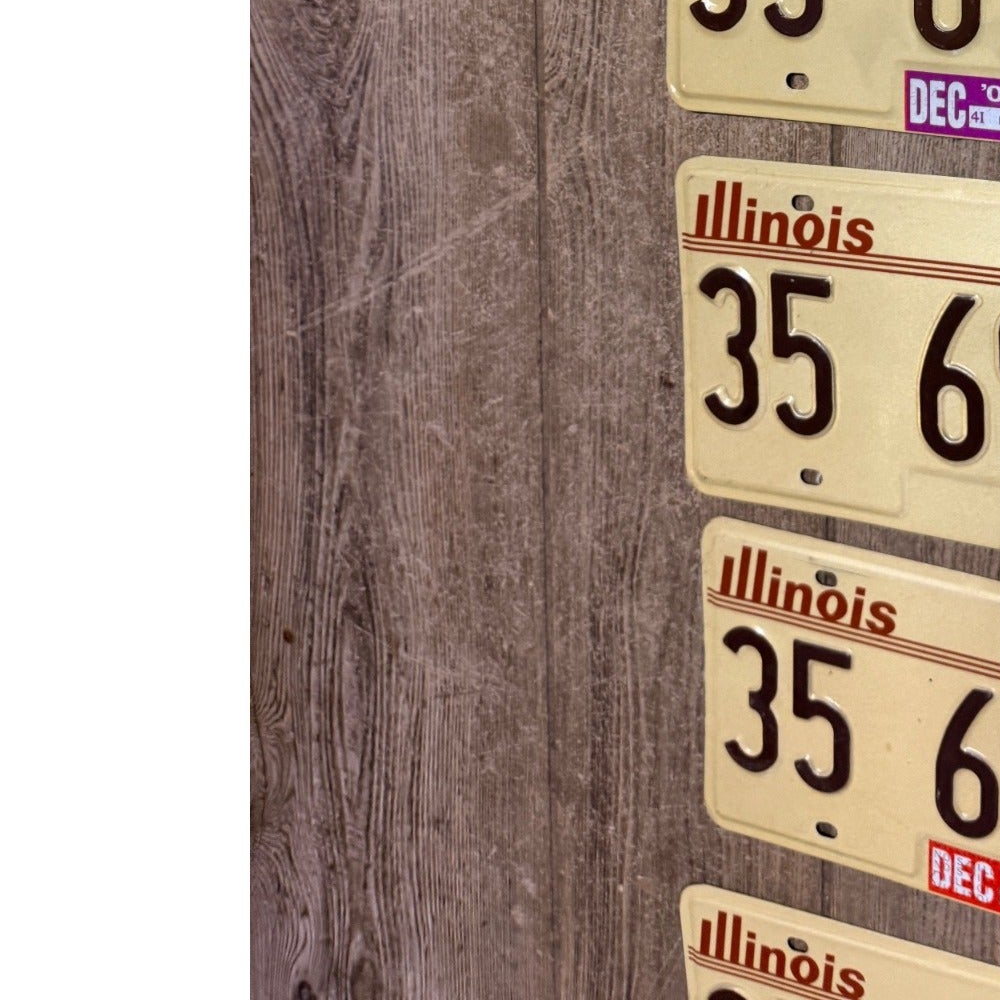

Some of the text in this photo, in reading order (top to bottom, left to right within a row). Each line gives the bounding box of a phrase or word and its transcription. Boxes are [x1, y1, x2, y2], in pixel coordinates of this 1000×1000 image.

[909, 78, 966, 129] DEC
[695, 181, 875, 255] Illinois
[700, 267, 835, 436] 35
[719, 546, 898, 636] Illinois
[723, 625, 852, 792] 35
[932, 847, 994, 903] DEC
[701, 911, 865, 999] Illinois
